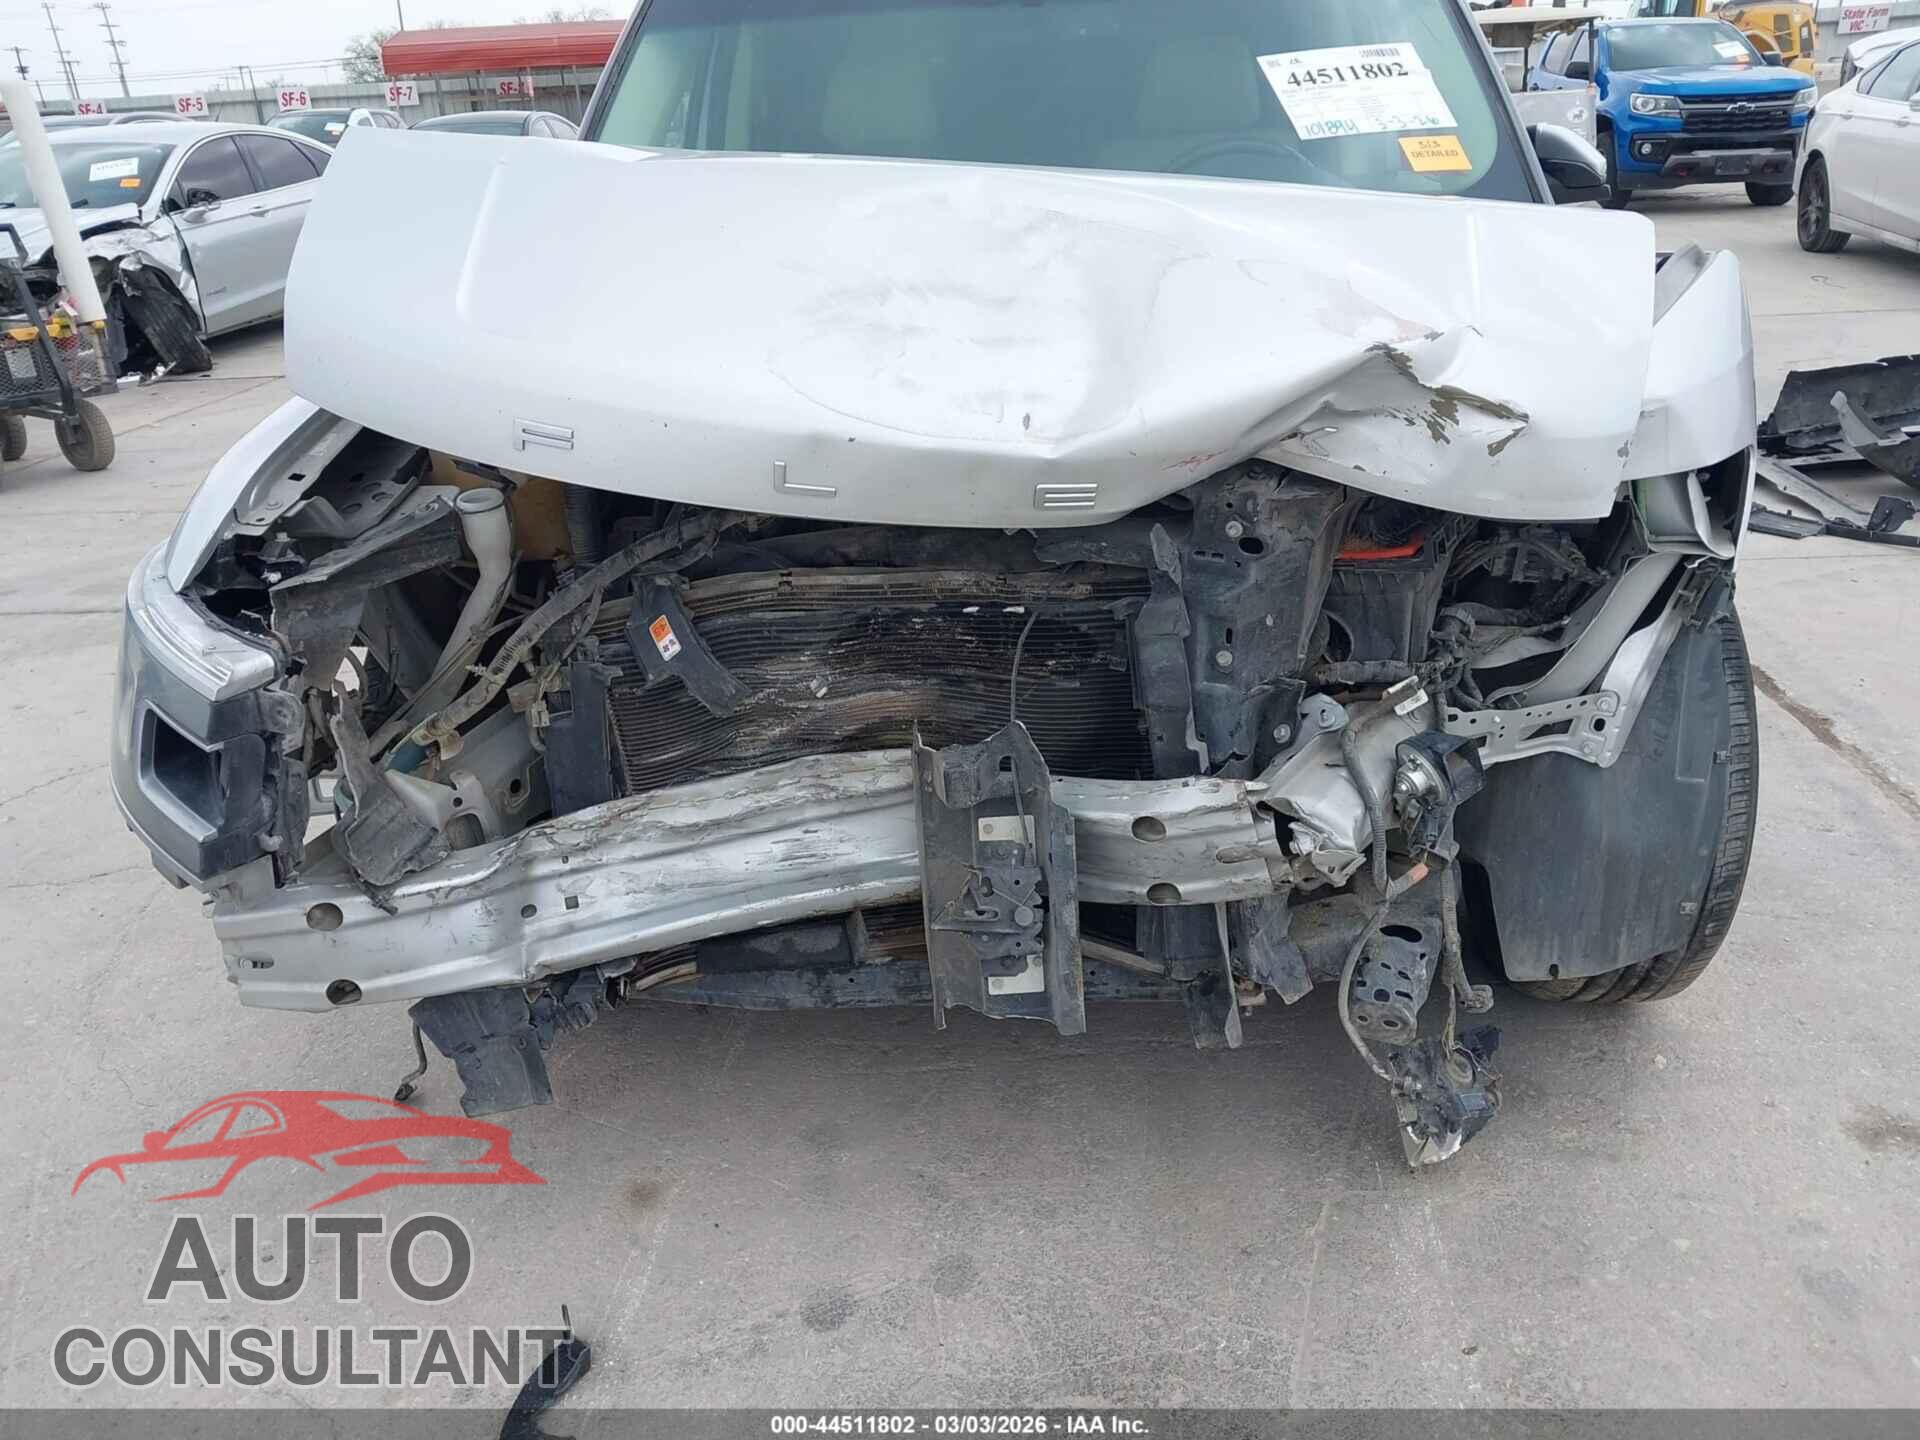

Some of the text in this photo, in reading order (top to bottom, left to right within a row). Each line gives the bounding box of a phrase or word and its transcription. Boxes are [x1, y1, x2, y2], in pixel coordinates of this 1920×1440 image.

[1842, 7, 1889, 20] State Farm
[1849, 20, 1865, 32] VIC
[1287, 62, 1409, 87] 44511802
[281, 91, 307, 107] SF-6
[389, 85, 413, 101] SF-7
[178, 96, 203, 114] SF-5
